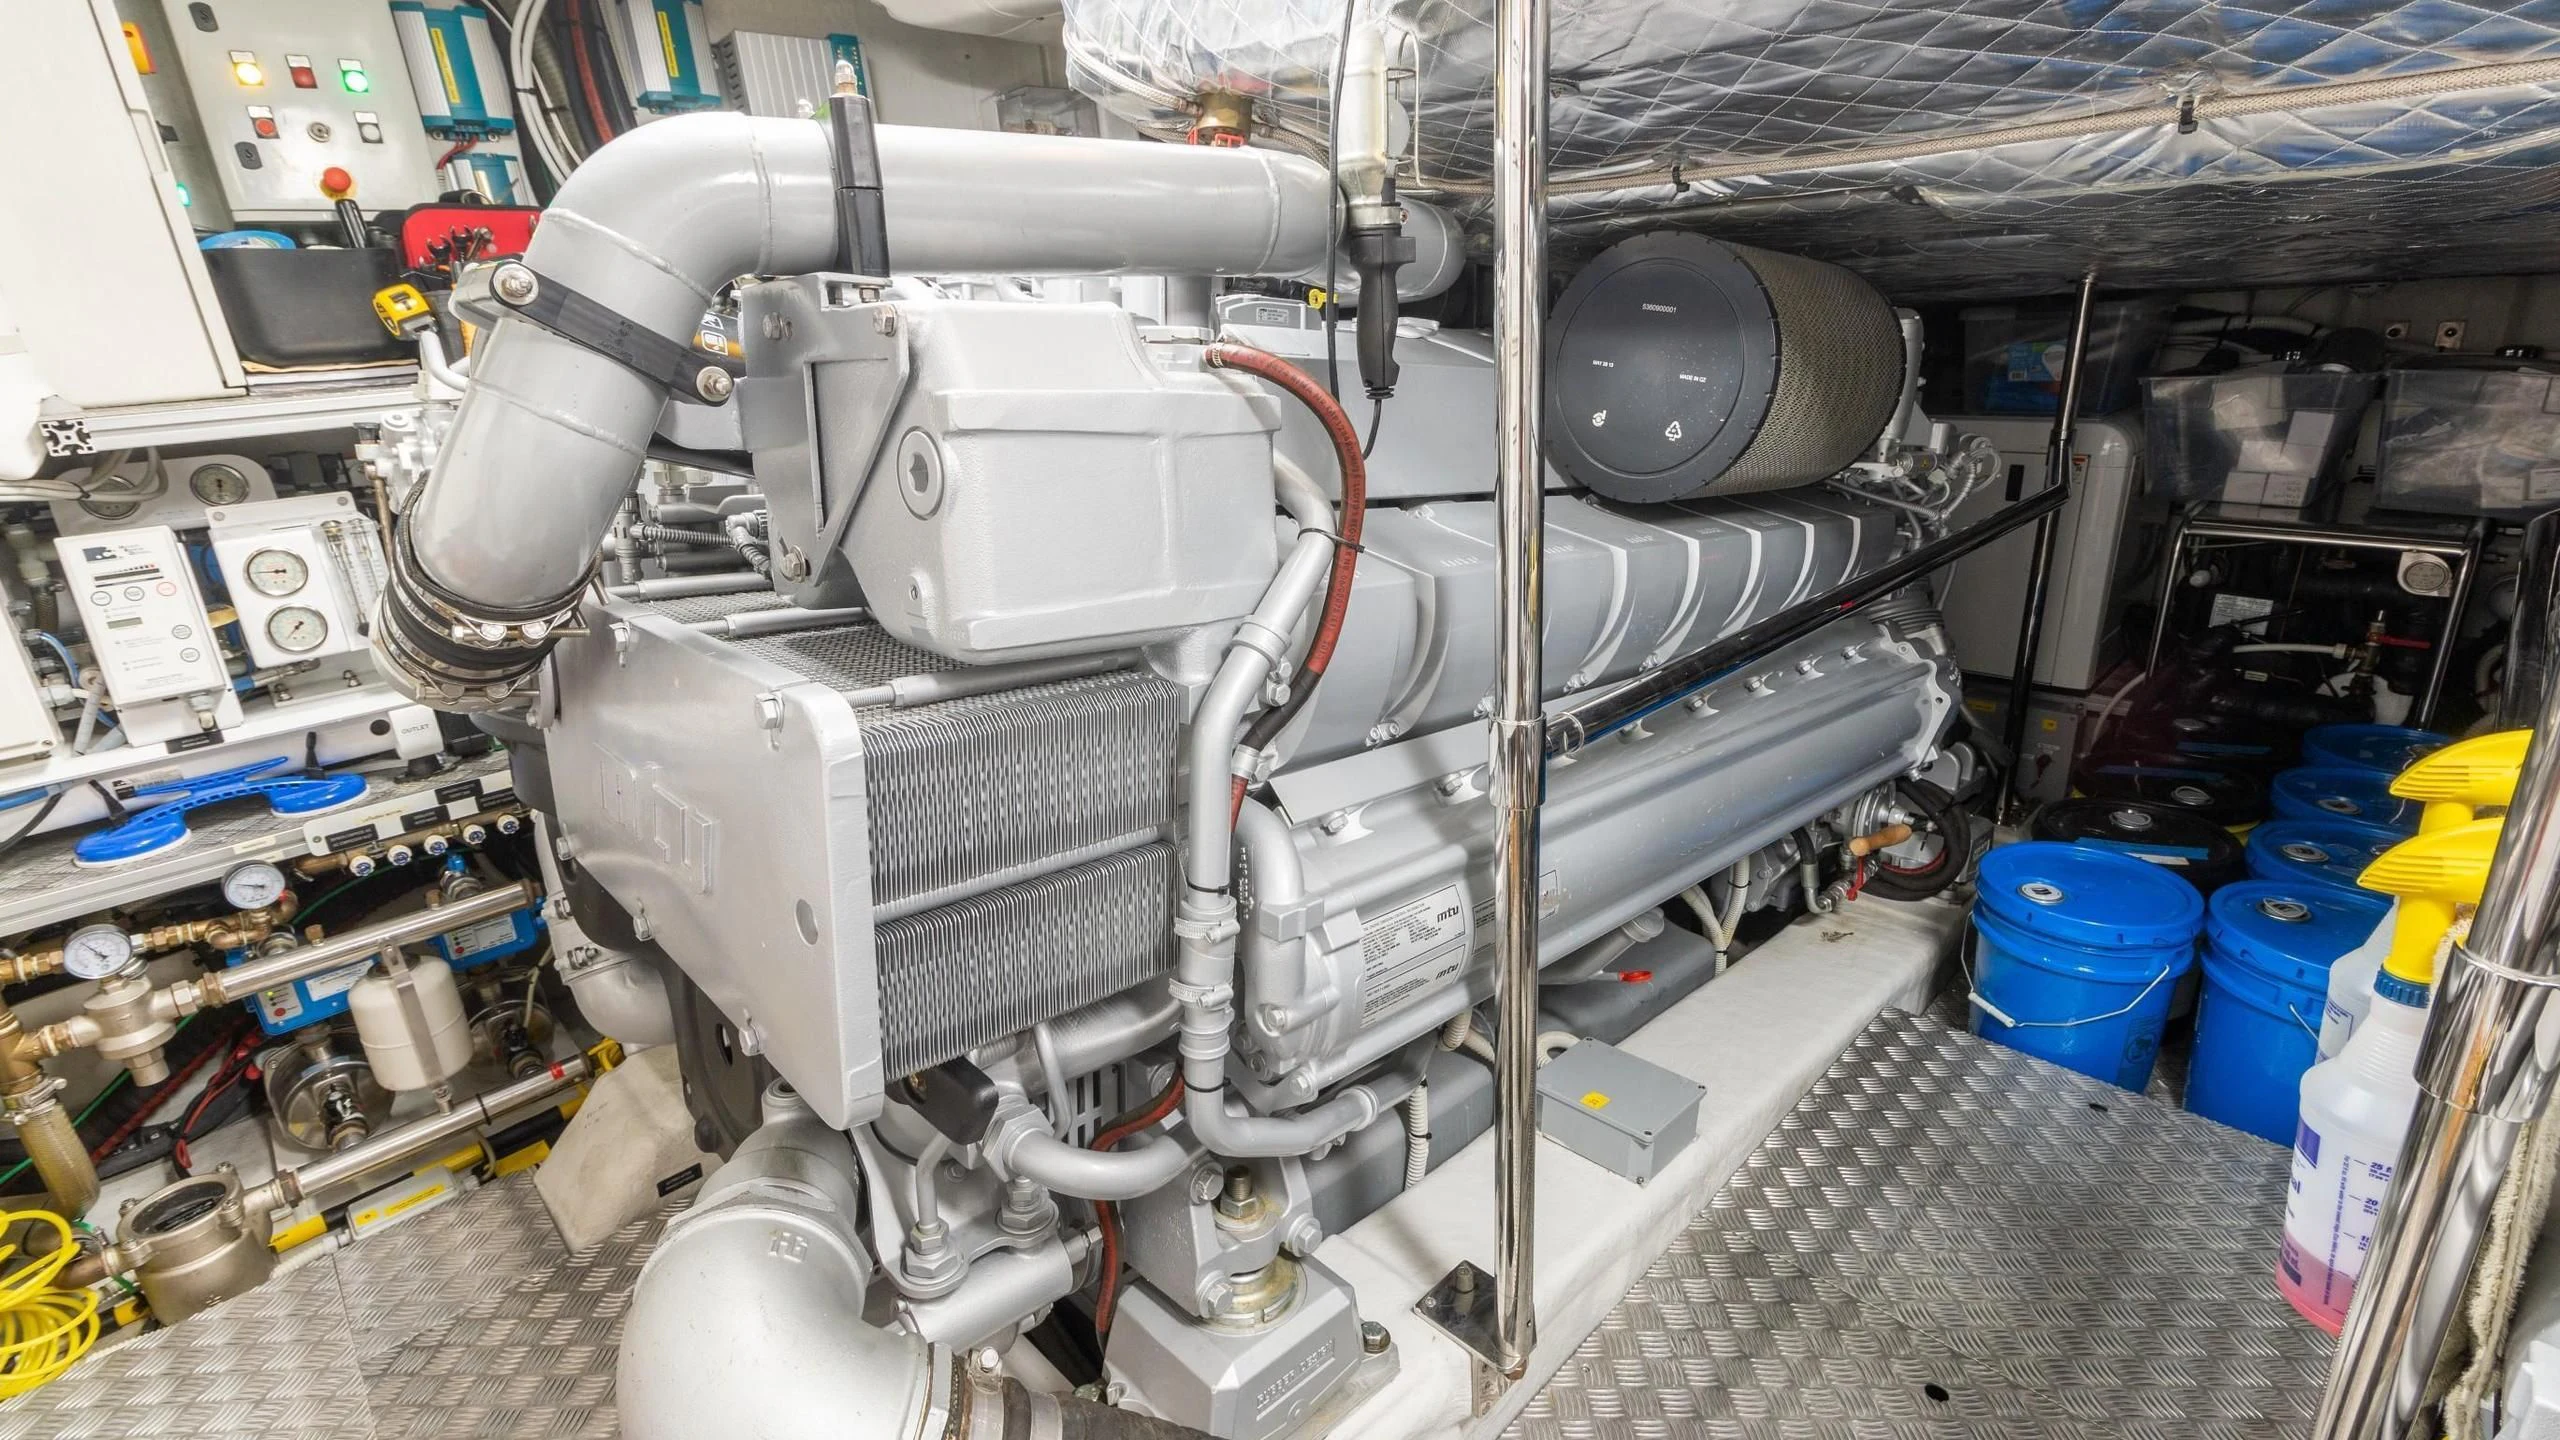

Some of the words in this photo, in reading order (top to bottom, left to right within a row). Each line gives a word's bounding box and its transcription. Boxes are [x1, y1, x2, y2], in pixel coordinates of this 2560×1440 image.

[401, 724, 429, 735] OUTLET
[1437, 905, 1459, 923] mtu
[1435, 963, 1459, 980] mtu
[2370, 1162, 2383, 1171] 25
[2365, 1198, 2378, 1207] 20
